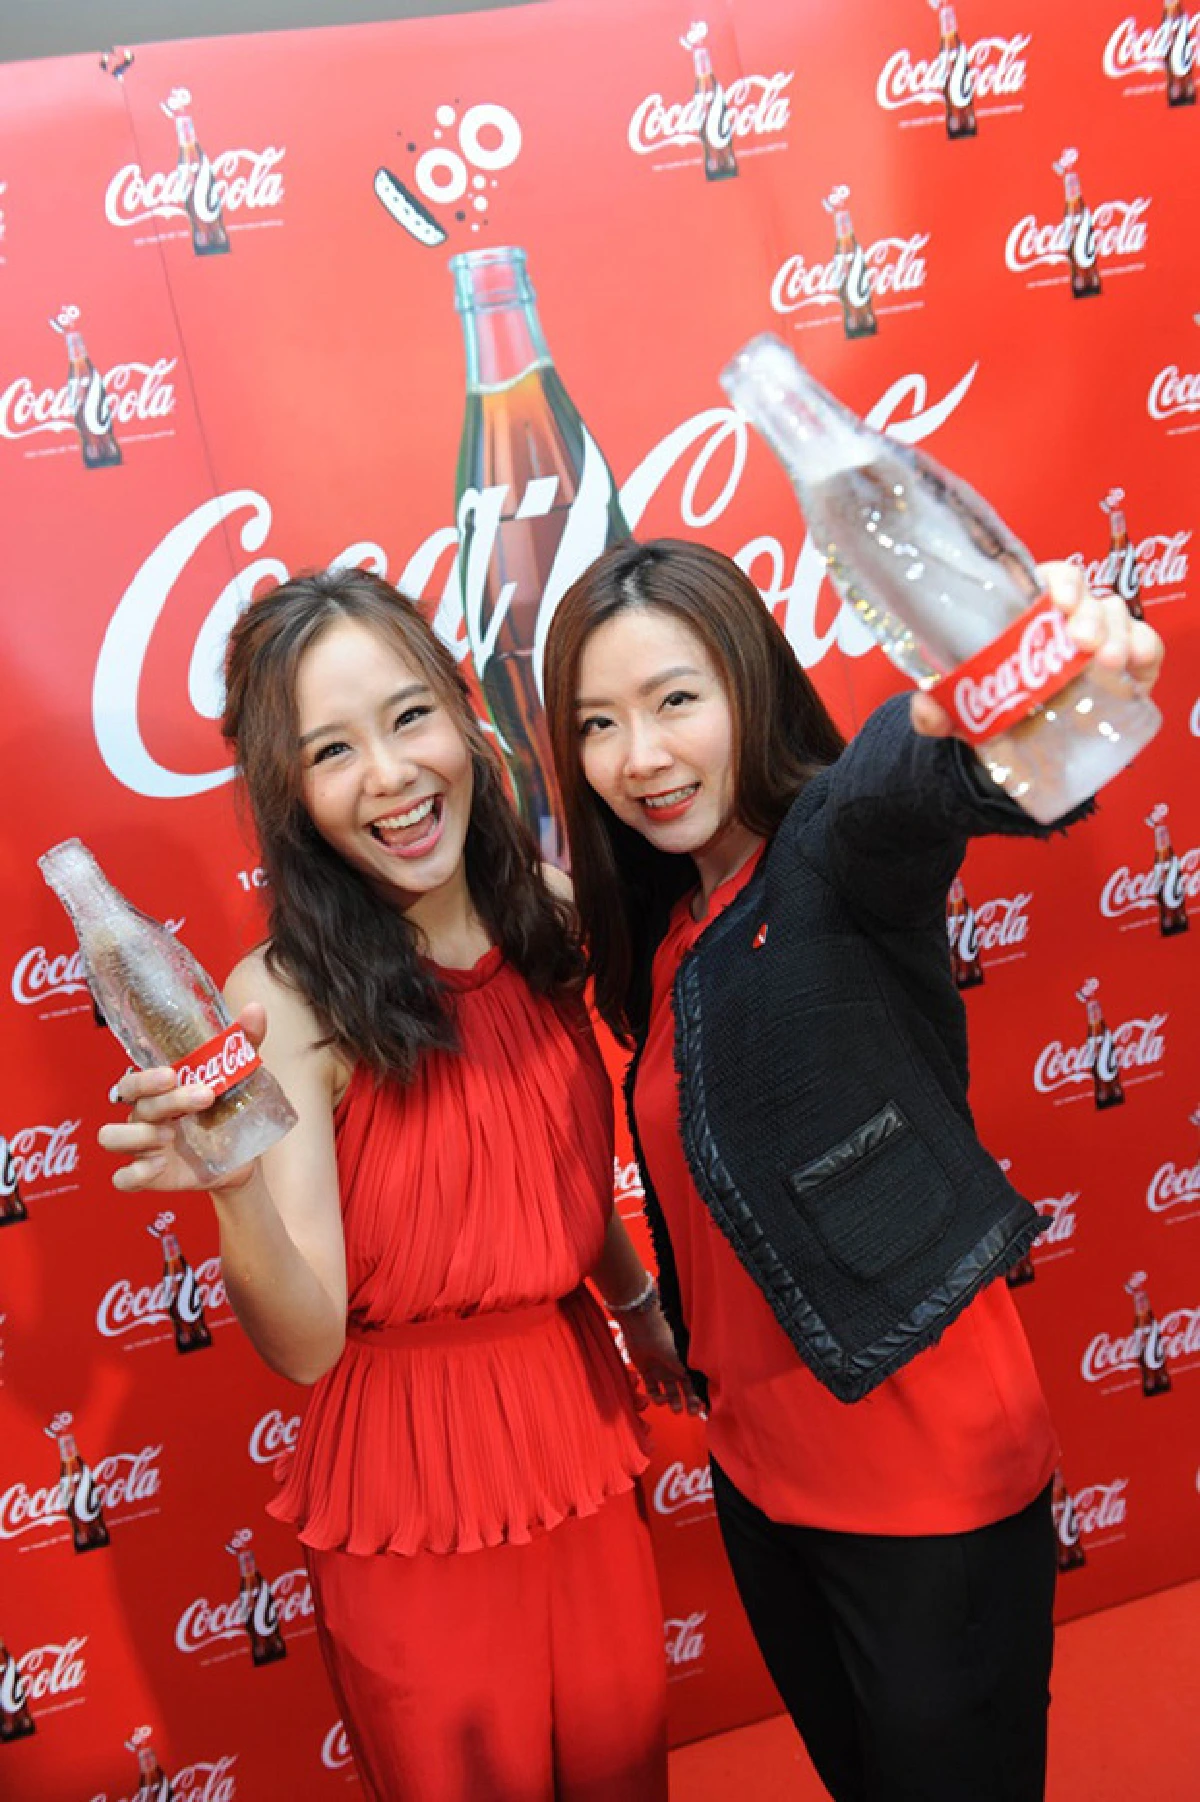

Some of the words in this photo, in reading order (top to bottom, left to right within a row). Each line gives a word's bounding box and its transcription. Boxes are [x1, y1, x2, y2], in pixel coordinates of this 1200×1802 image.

[877, 33, 1031, 110] Coca-Cola
[628, 70, 794, 154] Coca-Cola
[105, 146, 286, 226] Coca-Cola
[770, 232, 930, 313] Coca-Cola
[1005, 198, 1152, 272] Coca-Cola
[1034, 1013, 1168, 1092] Coca-Cola
